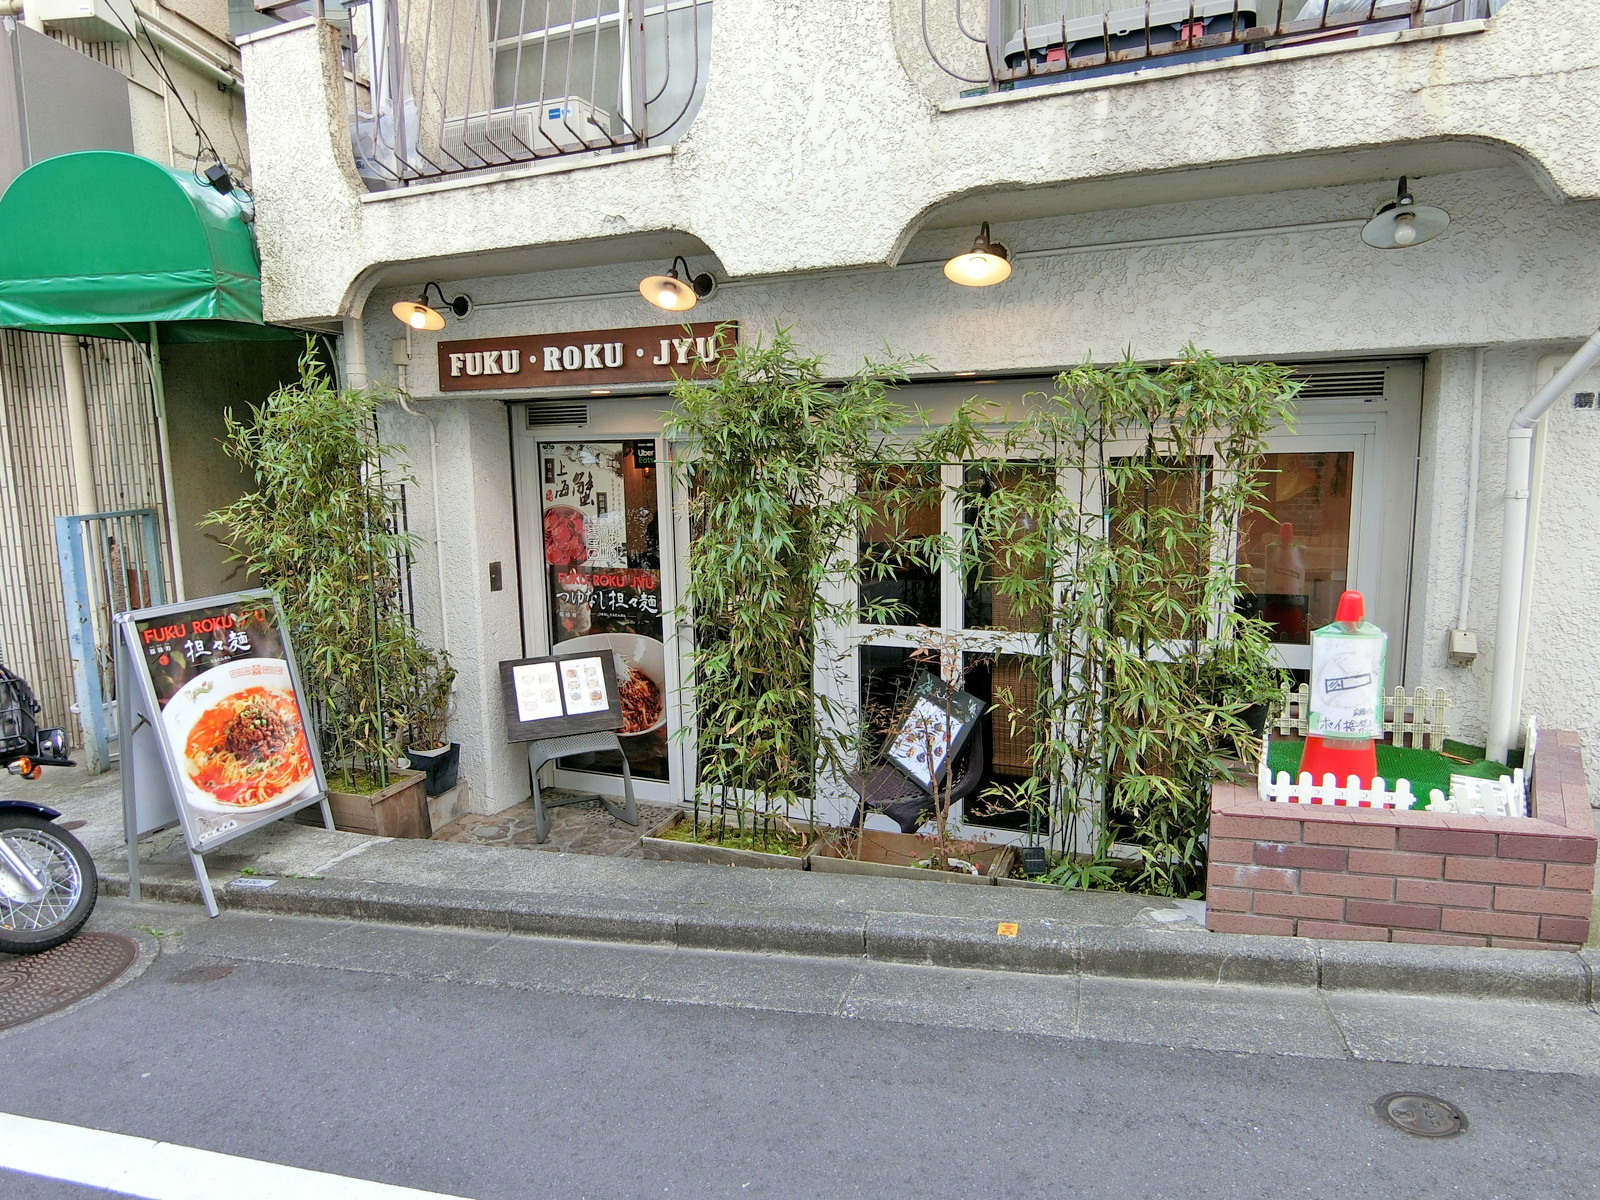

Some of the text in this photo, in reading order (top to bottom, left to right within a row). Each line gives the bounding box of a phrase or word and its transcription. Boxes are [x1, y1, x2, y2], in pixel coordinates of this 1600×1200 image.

[449, 336, 717, 377] FUKU ROKU JYU
[637, 449, 654, 457] Uber
[557, 572, 655, 590] FUKU ROKU JYU
[143, 623, 187, 644] FUKU
[191, 614, 233, 635] ROKU
